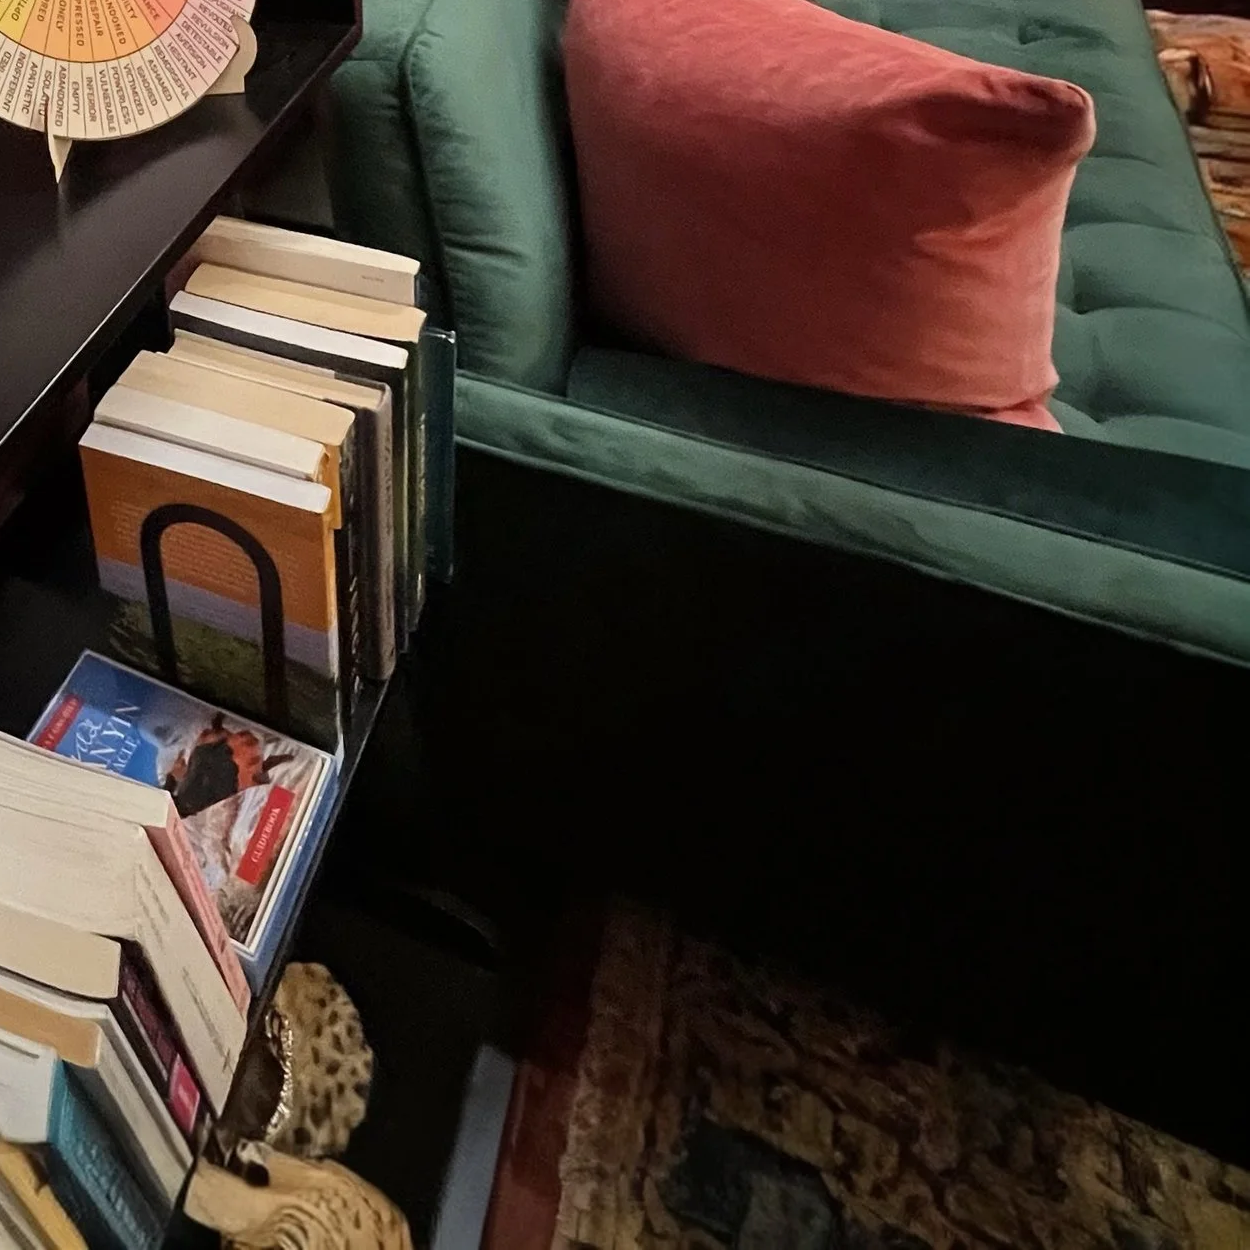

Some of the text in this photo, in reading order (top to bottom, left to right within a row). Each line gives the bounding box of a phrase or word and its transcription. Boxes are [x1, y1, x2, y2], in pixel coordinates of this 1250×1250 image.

[191, 13, 229, 50] REVULSION
[199, 3, 233, 33] REVOLTED
[168, 42, 196, 81] HESITANT
[176, 33, 206, 69] AVERSION
[181, 20, 224, 64] DETESTABLE
[3, 51, 26, 113] INDIFFERENT
[22, 62, 38, 114] APATHETIC
[111, 66, 131, 125] POWERLESS
[123, 63, 144, 116] VICTIMIZED
[137, 66, 157, 106] IGNORED
[148, 59, 172, 101] ASHAMED
[154, 45, 189, 100] REMORSEFUL
[55, 65, 66, 127] ABANDONED
[72, 81, 80, 115] EMPTY
[86, 76, 97, 122] INFERIOR
[99, 69, 116, 133] VULNERABLE
[251, 808, 281, 863] GUIDEBOOK
